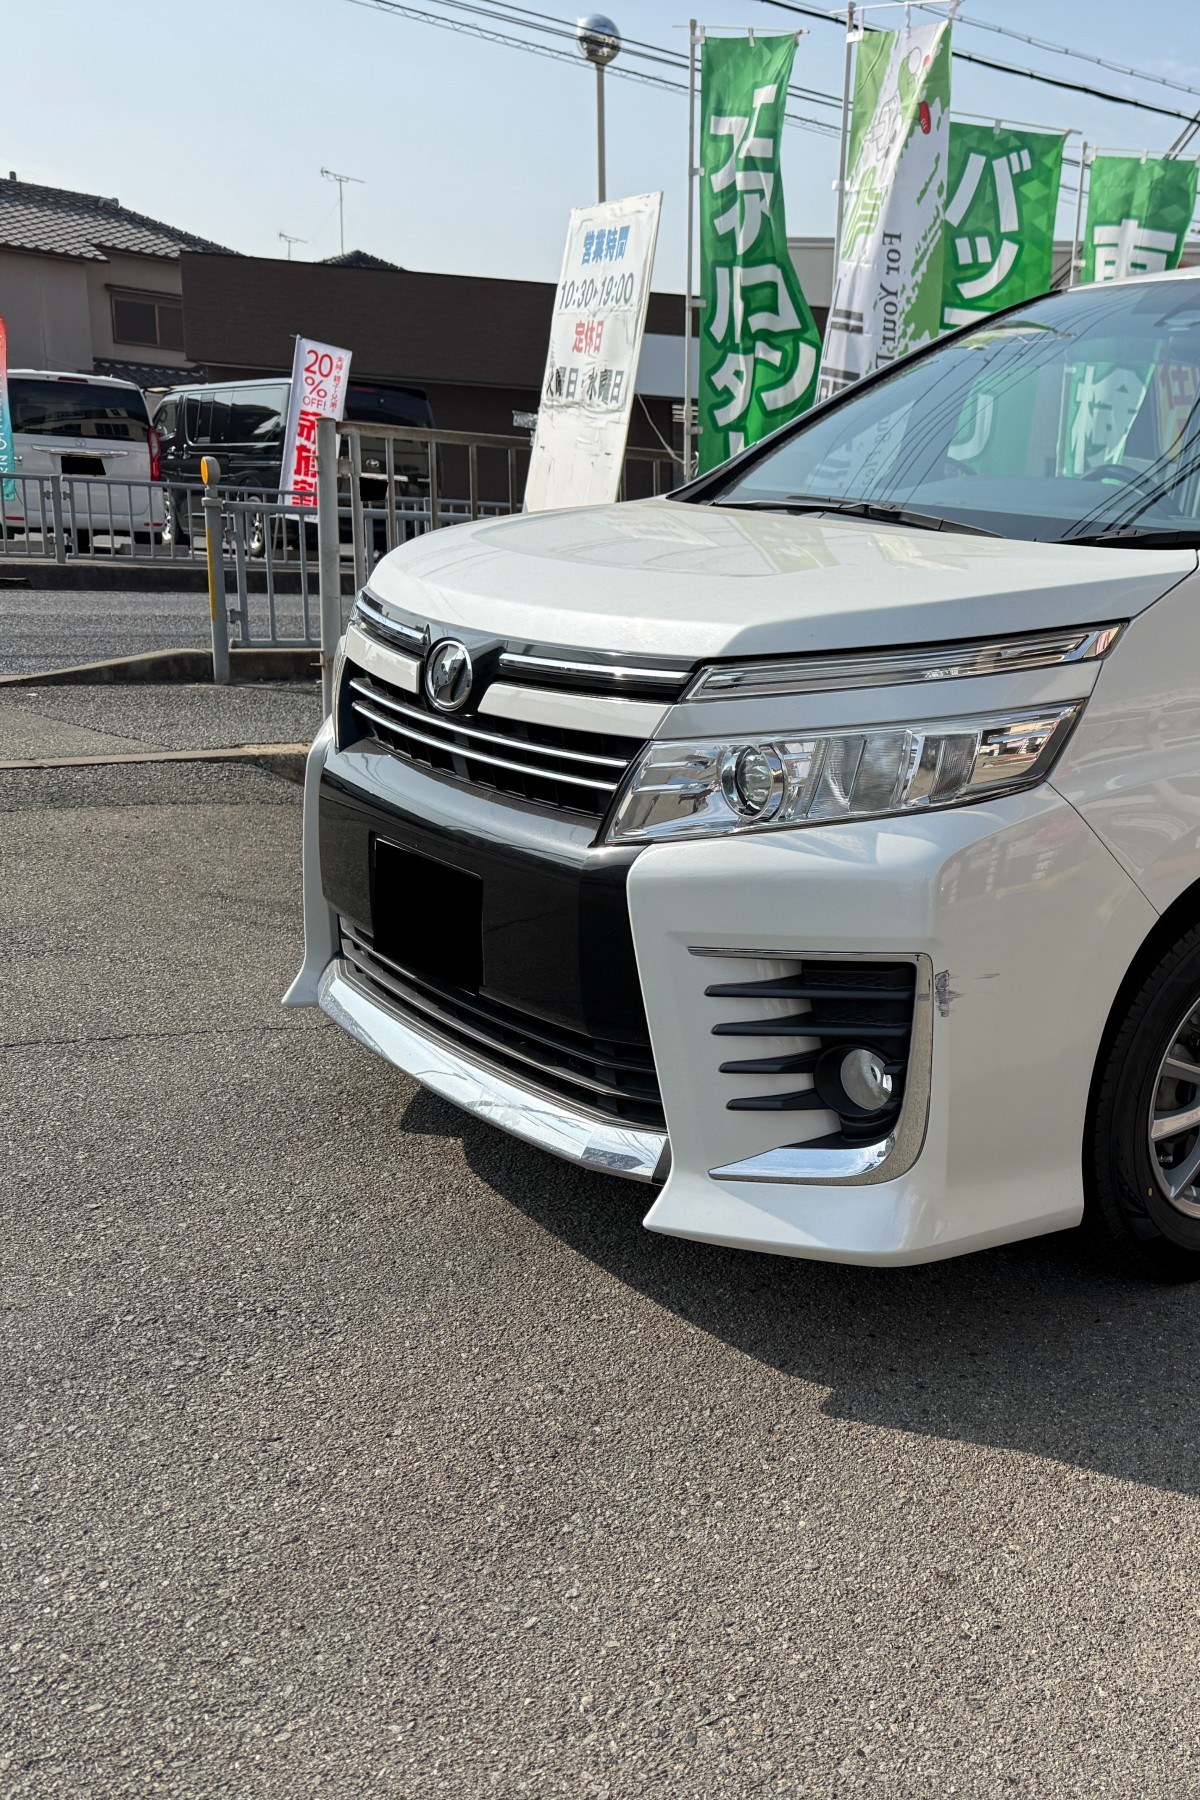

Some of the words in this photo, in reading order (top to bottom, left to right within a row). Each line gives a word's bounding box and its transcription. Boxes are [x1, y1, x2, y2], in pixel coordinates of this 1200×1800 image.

[581, 225, 630, 265] 営業時間
[737, 84, 817, 412] エアコン
[559, 278, 595, 310] 10:30
[598, 272, 634, 307] 19:00
[572, 319, 605, 354] 定休日
[303, 349, 334, 378] 20
[302, 395, 327, 411] OFF!
